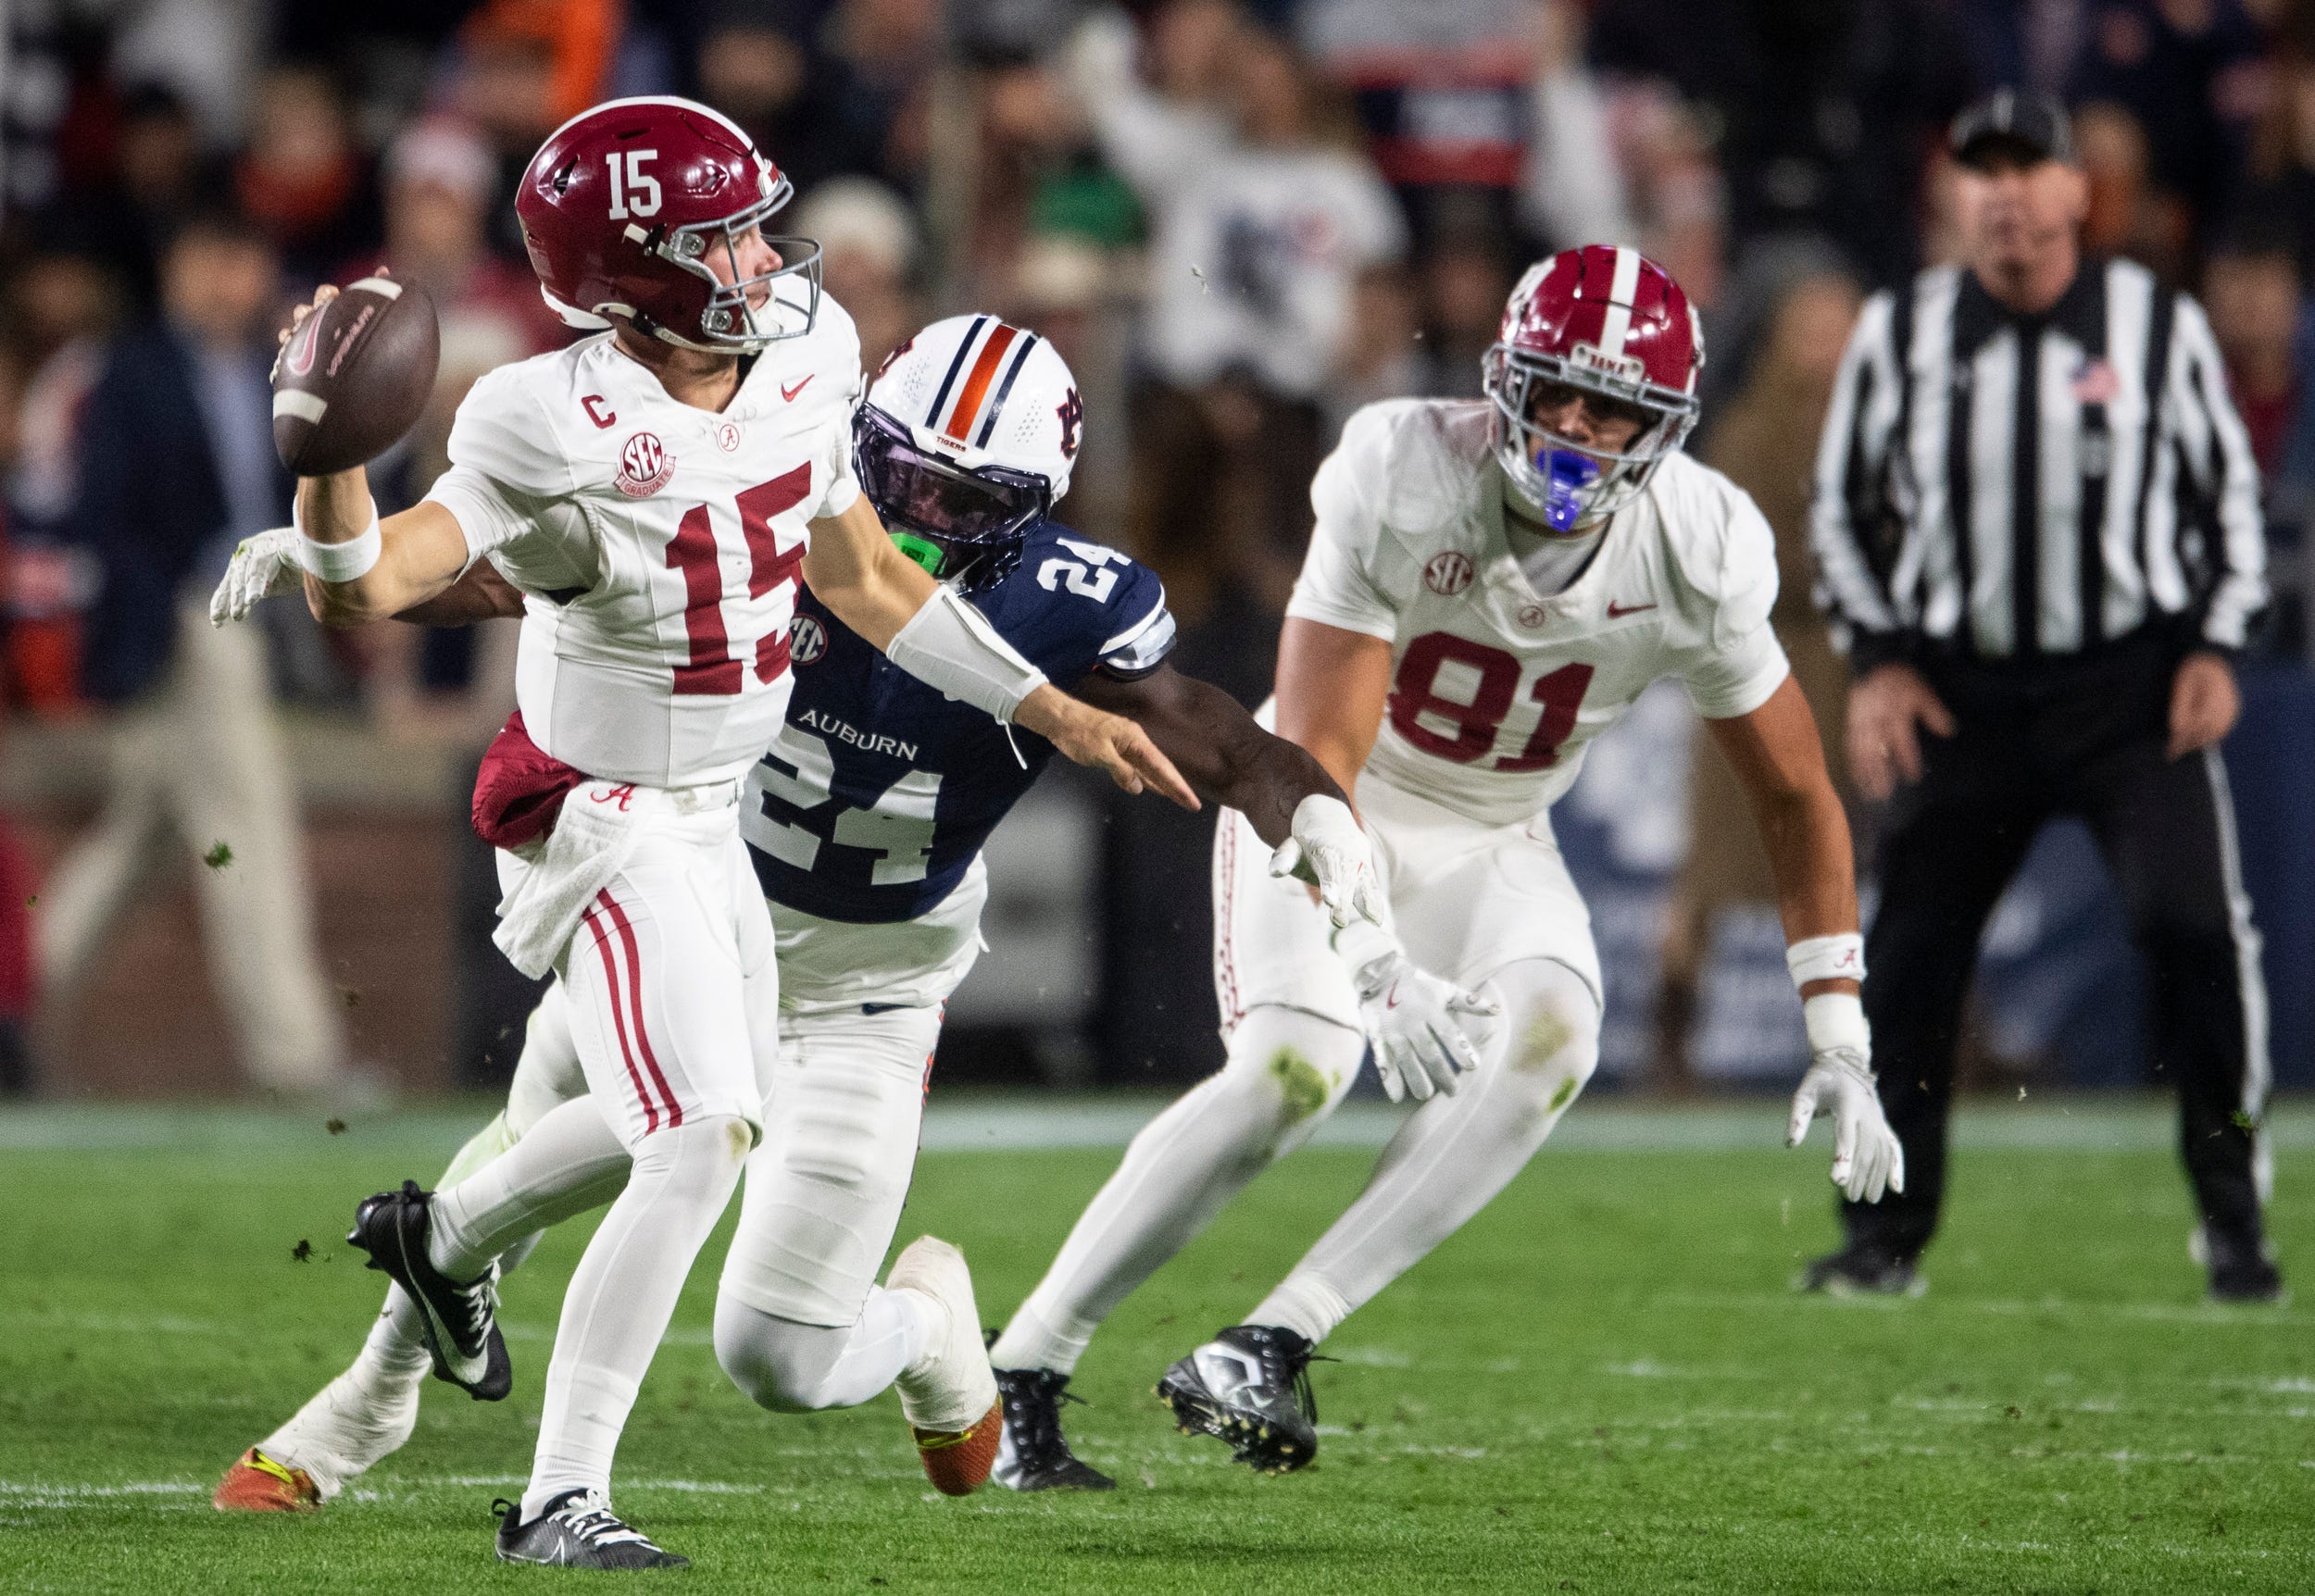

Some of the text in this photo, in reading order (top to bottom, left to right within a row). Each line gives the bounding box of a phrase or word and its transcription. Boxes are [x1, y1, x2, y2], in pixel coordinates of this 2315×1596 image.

[606, 149, 662, 220] 15
[582, 394, 617, 429] C
[623, 433, 662, 481] SEC
[936, 436, 967, 452] TIGERS
[623, 468, 672, 497] GRADUATE
[666, 460, 812, 694] 15
[1036, 538, 1132, 604] 24
[1428, 554, 1471, 593] SEC
[1388, 630, 1595, 773] 81
[798, 710, 919, 761] AUBURN
[738, 723, 944, 886] 24
